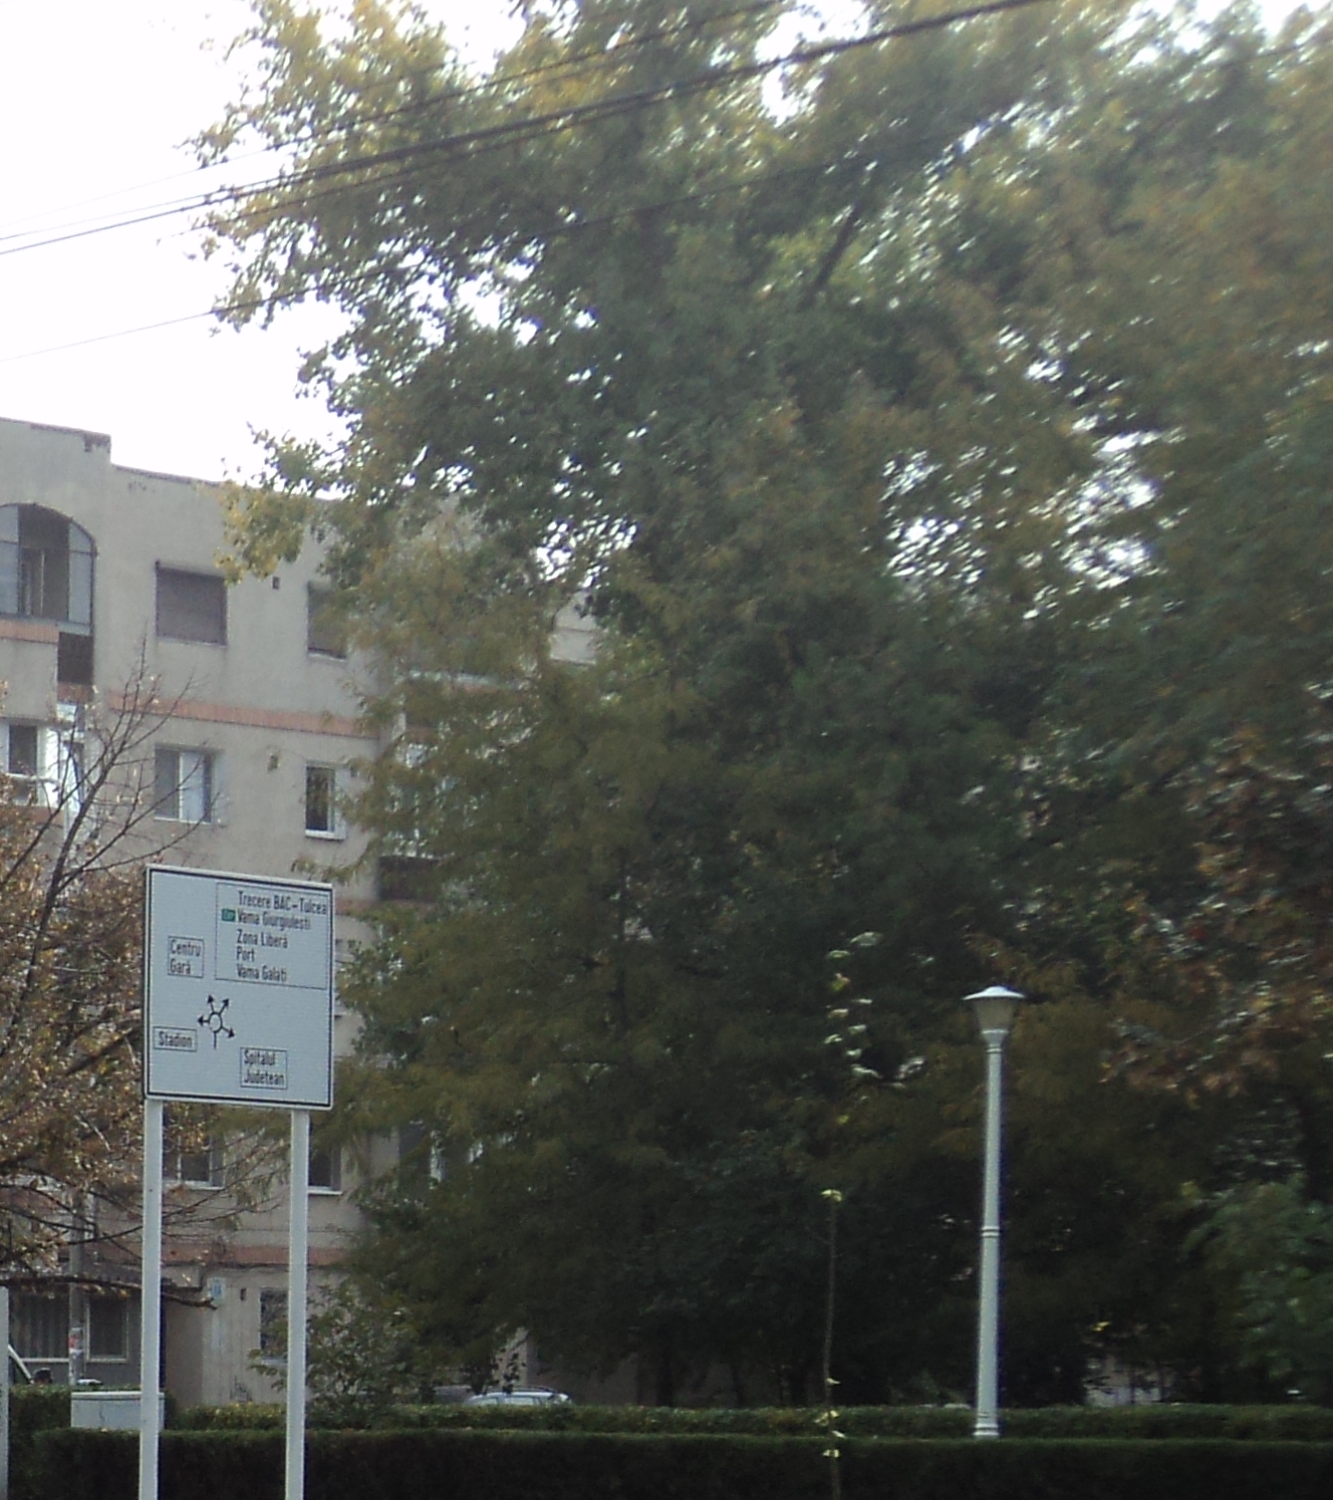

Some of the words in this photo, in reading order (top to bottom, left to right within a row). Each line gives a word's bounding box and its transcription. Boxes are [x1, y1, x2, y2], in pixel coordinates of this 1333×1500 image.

[238, 891, 271, 909] Trecere
[236, 929, 258, 946] Zona
[170, 939, 202, 957] Centru
[236, 946, 256, 963] Port
[236, 963, 260, 980] Vama
